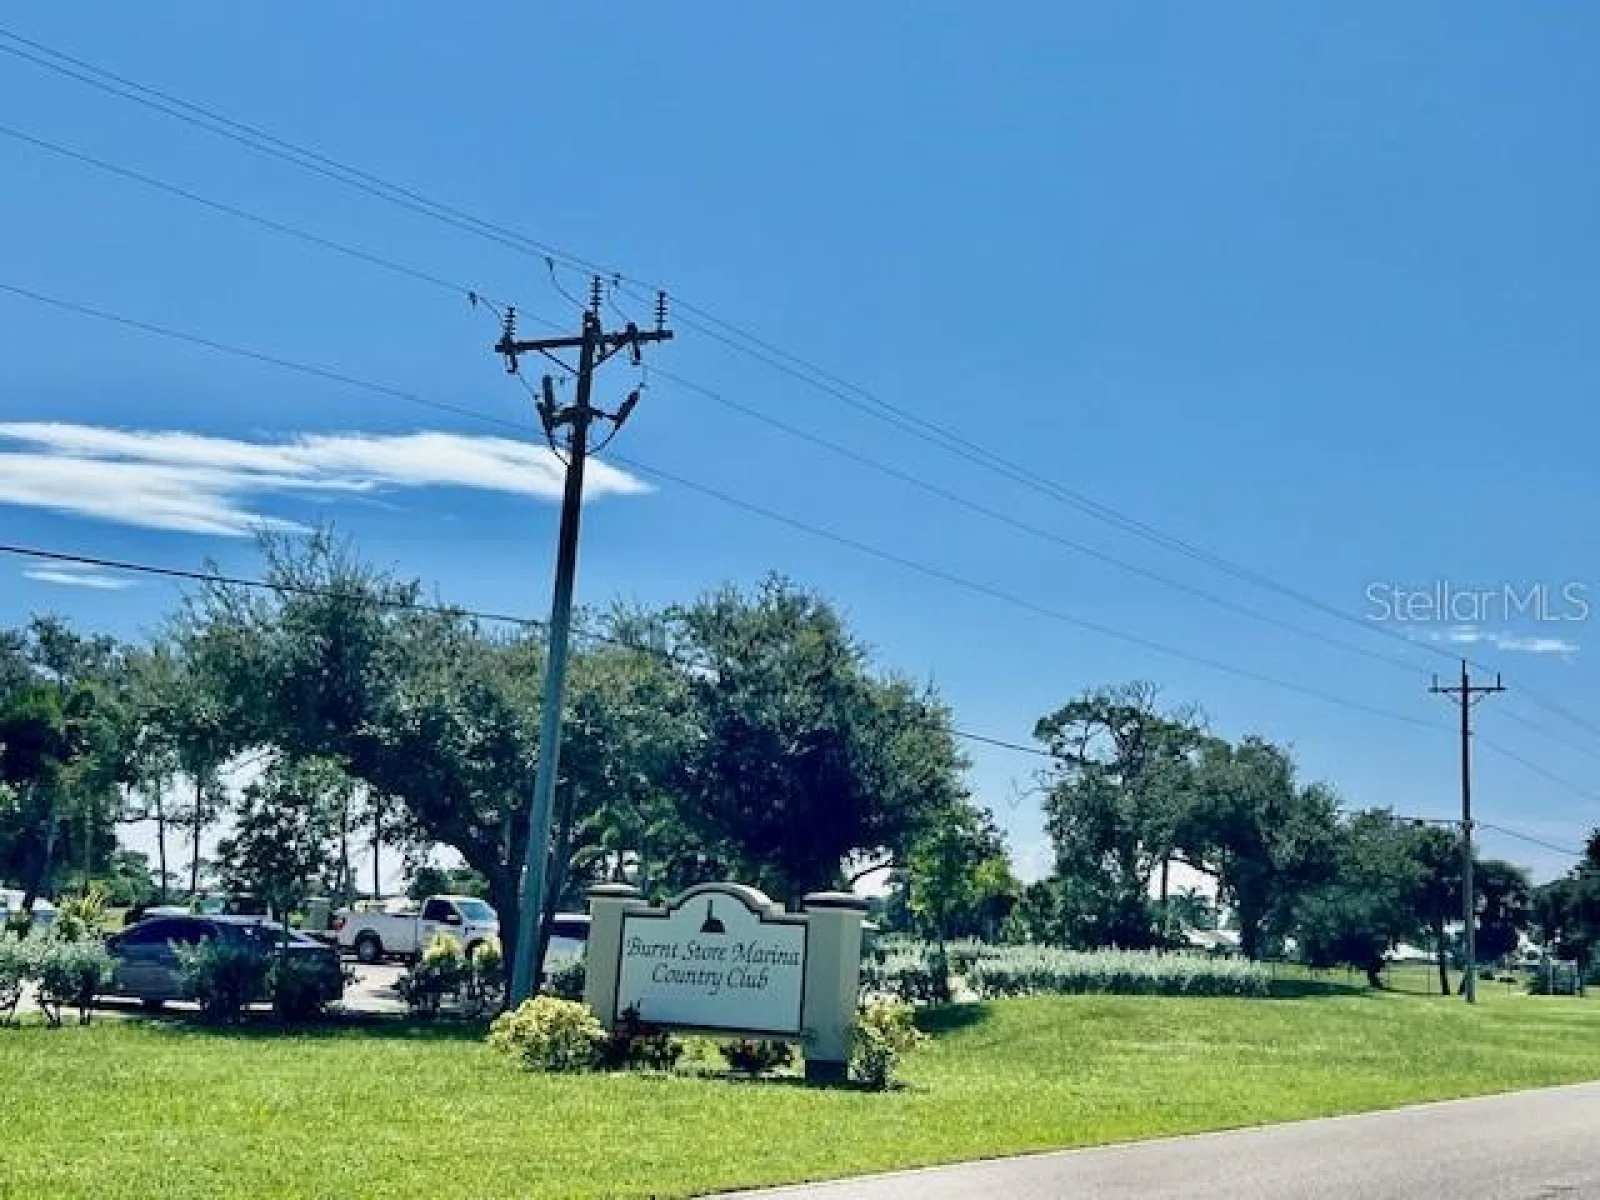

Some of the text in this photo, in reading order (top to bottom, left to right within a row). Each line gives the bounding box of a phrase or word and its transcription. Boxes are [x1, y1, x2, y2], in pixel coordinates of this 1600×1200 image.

[627, 937, 800, 965] Burnt Store Marina
[652, 962, 770, 995] Country Club
